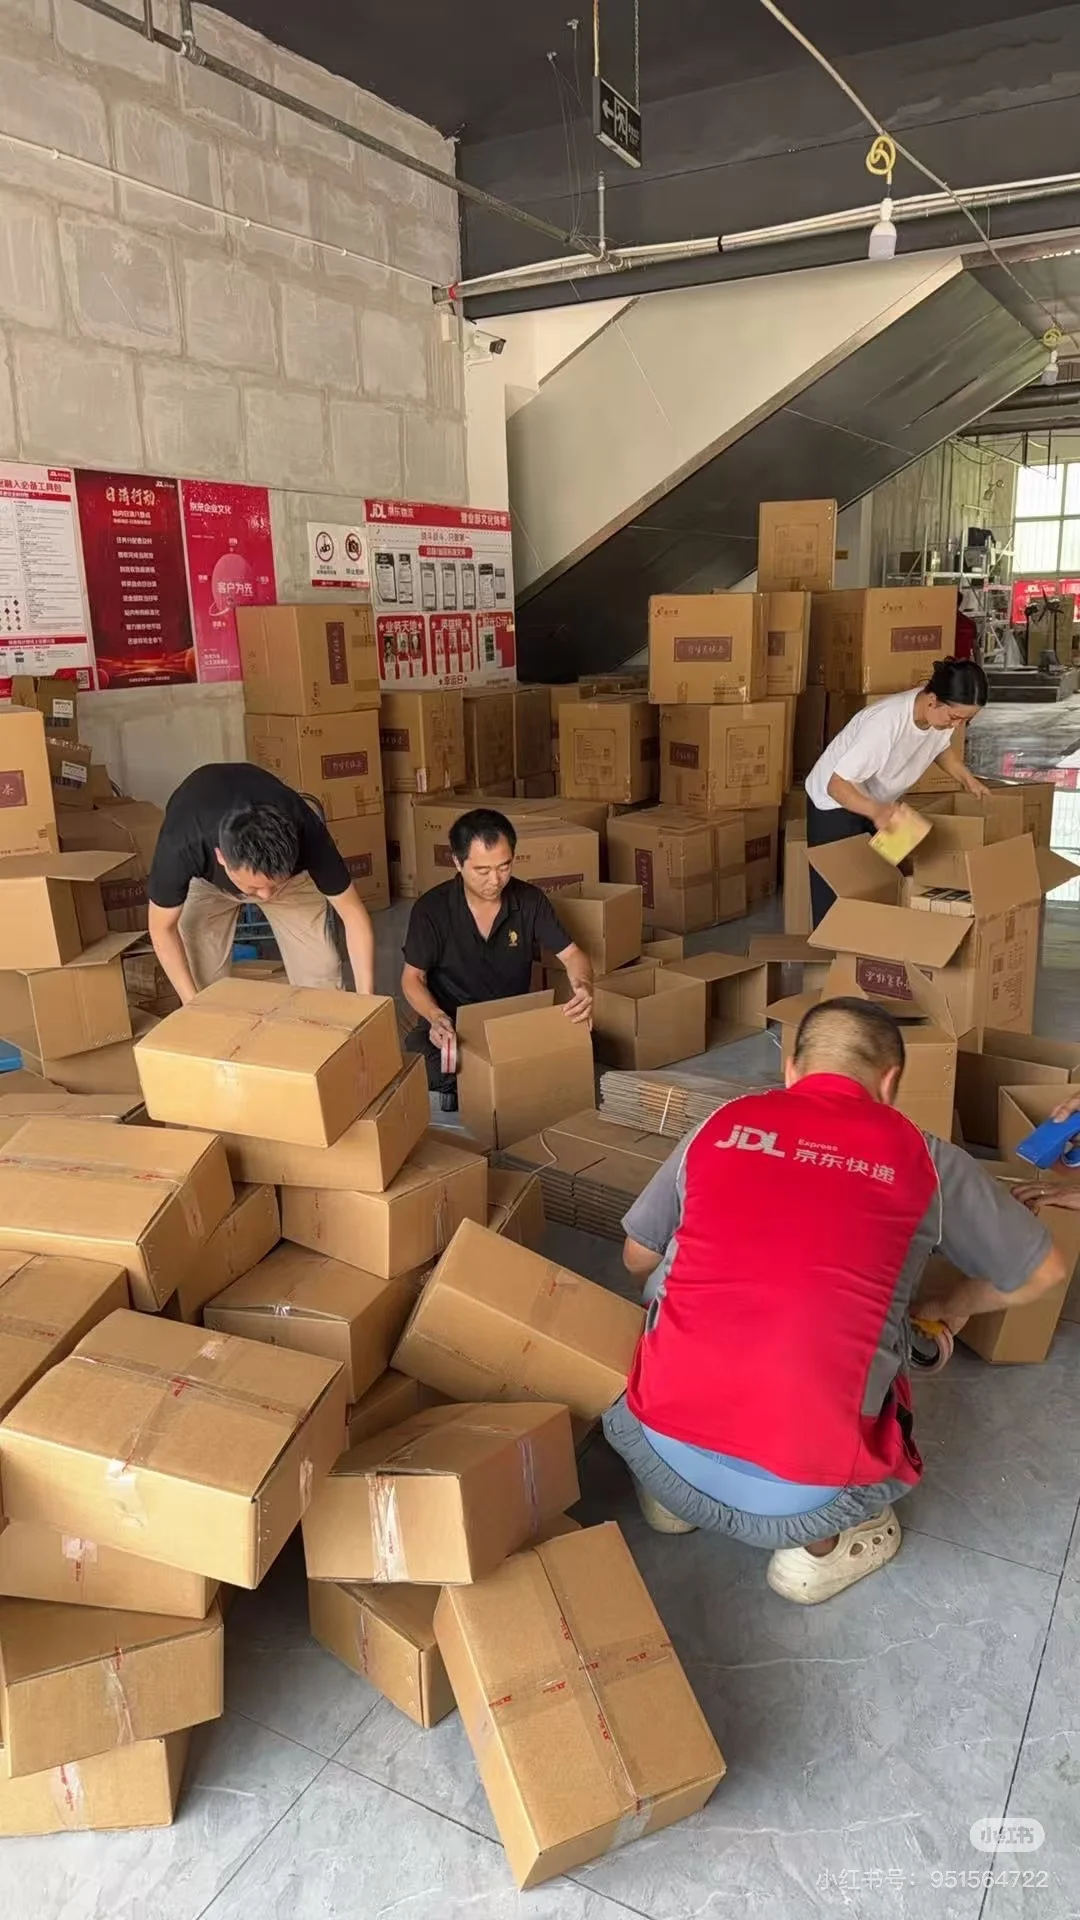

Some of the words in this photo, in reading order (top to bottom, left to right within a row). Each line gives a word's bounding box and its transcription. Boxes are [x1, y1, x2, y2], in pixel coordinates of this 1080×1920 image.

[369, 503, 387, 519] JDL
[217, 582, 253, 594] 客户为先
[713, 1124, 786, 1158] JDL
[797, 1138, 839, 1152] Express
[792, 1148, 896, 1184] 京东快递
